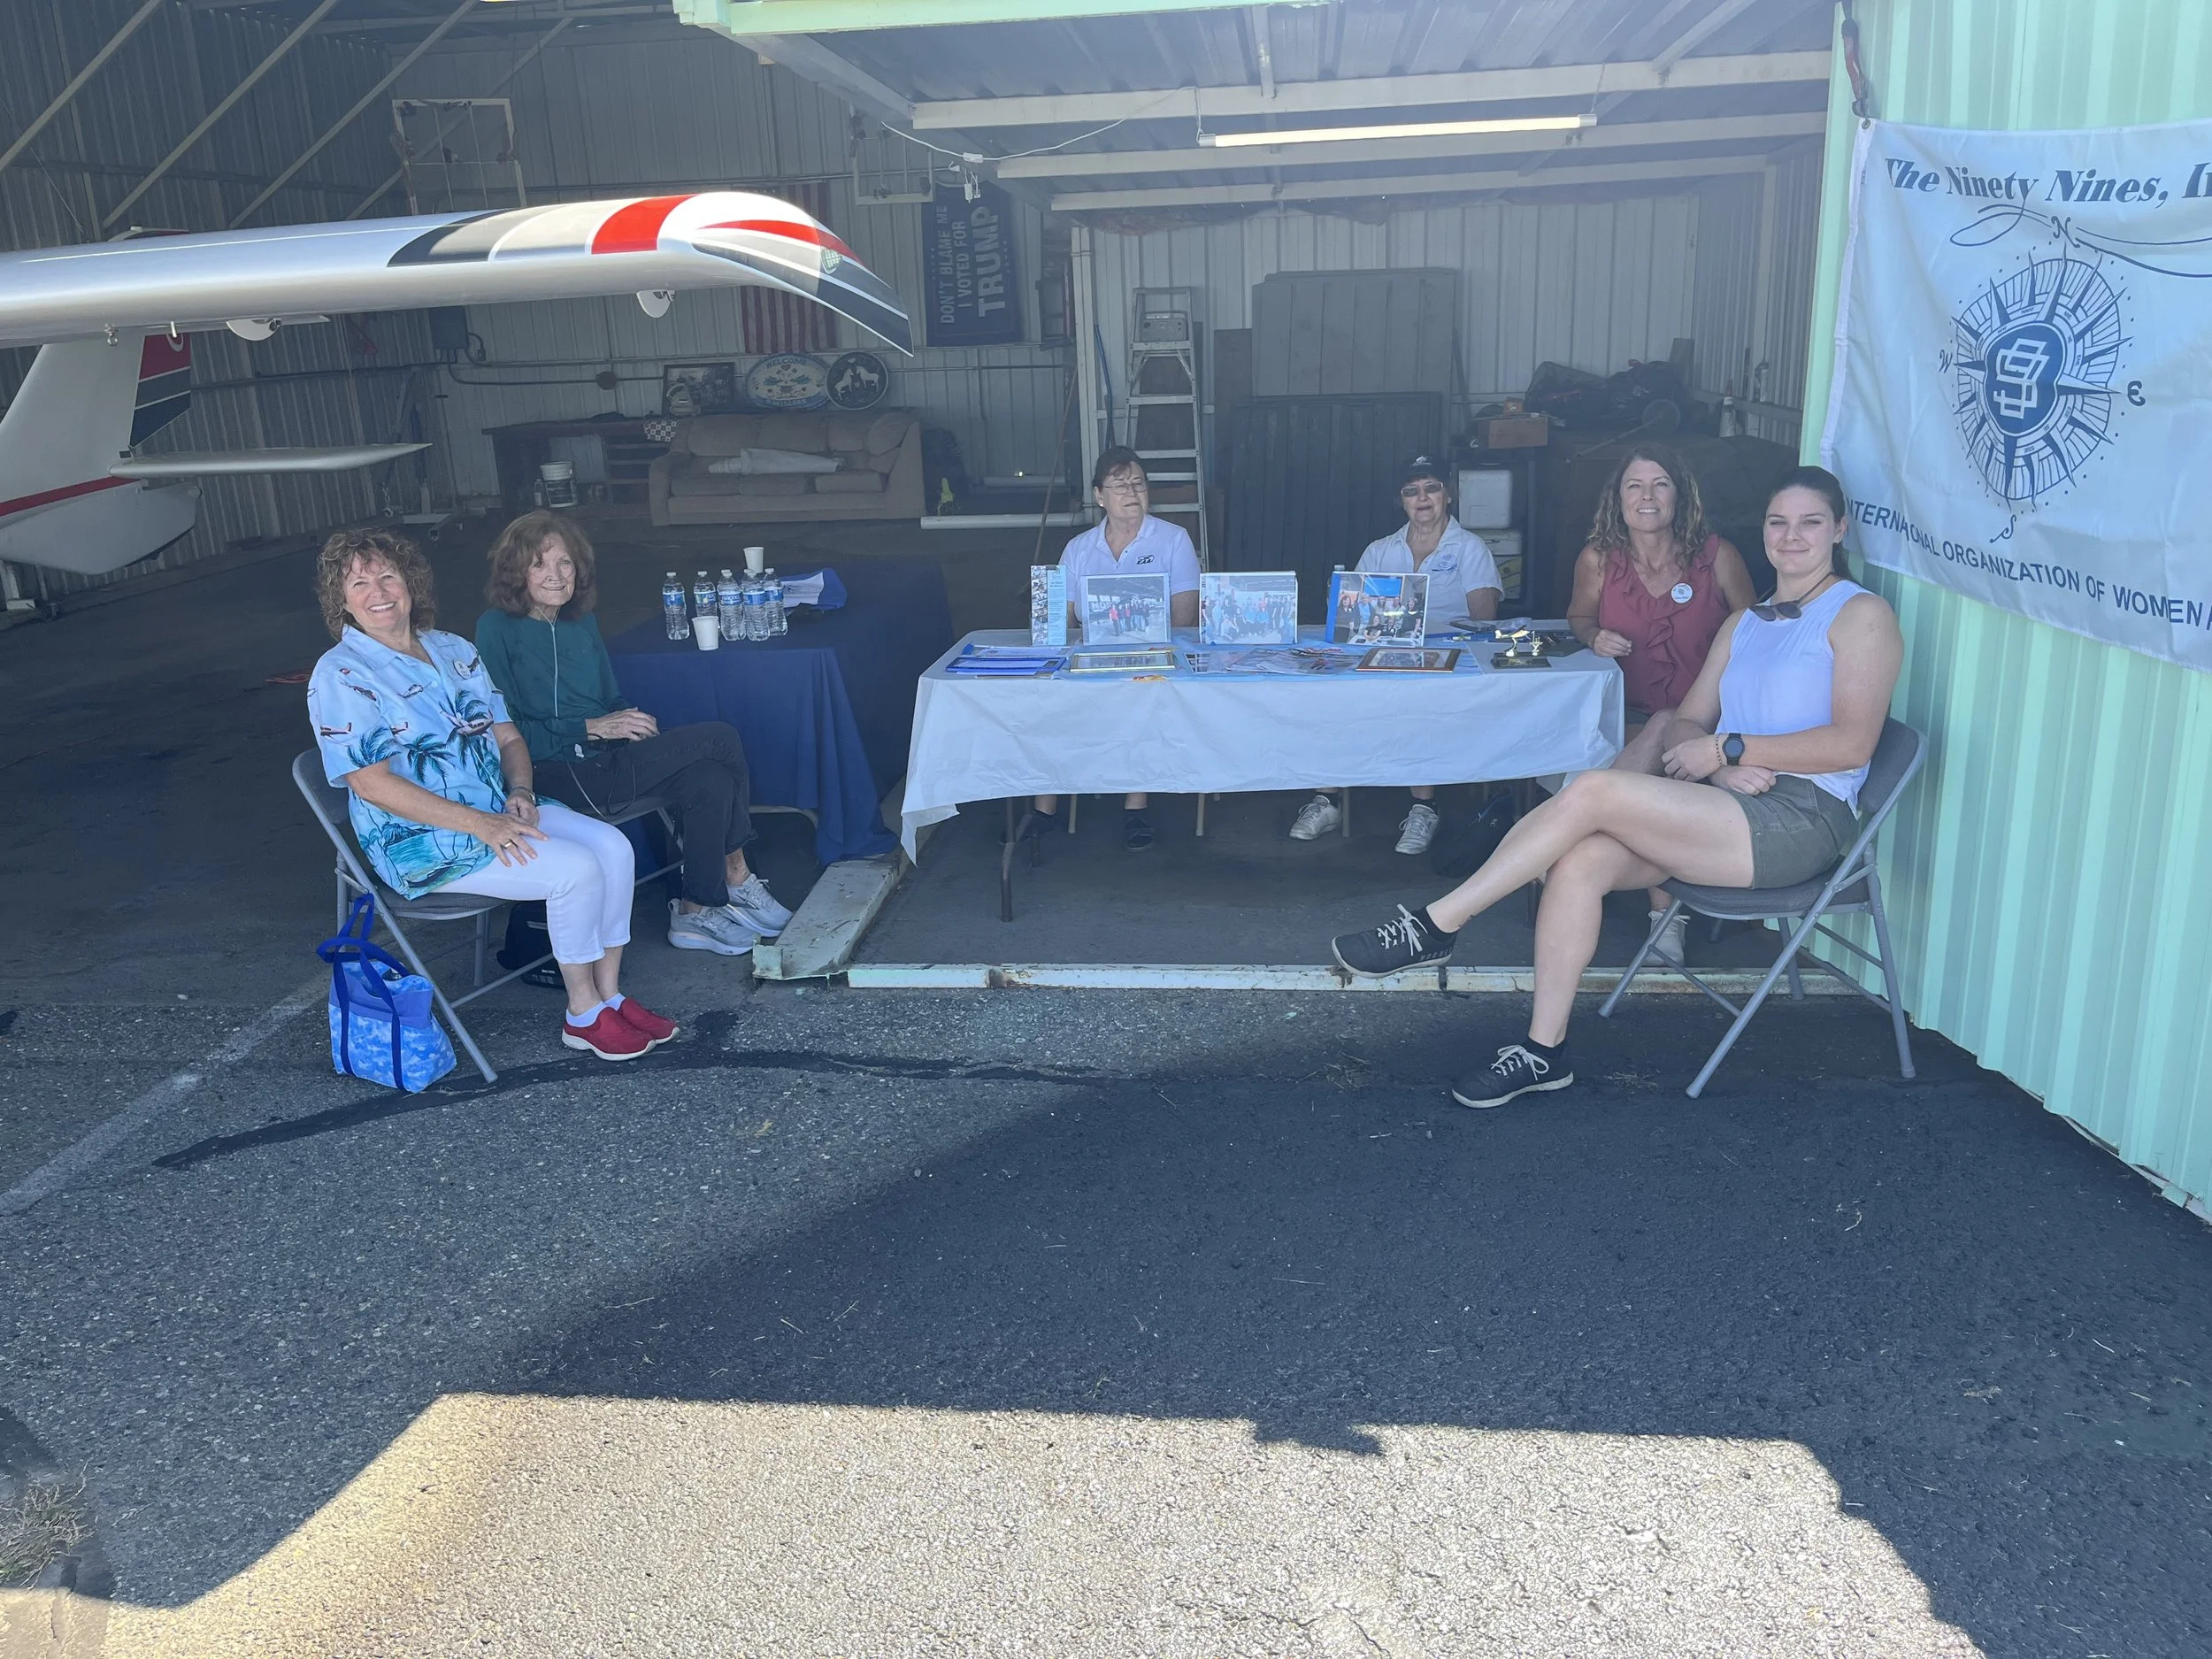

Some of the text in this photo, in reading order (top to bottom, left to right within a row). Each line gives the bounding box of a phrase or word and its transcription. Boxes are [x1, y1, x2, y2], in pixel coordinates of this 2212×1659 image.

[1886, 158, 1940, 193] The
[1945, 166, 2039, 214] Ninety
[2045, 169, 2169, 209] Nines,
[951, 221, 967, 248] FOR
[2050, 216, 2081, 248] N
[936, 204, 956, 324] DON'T BLAME ME
[956, 253, 972, 298] VOTED
[971, 206, 1006, 318] TRUMP
[766, 357, 807, 370] WELCOME
[1943, 541, 2080, 593] ORGANIZATION
[2085, 575, 2106, 602] OF
[2112, 584, 2203, 627] WOMEN
